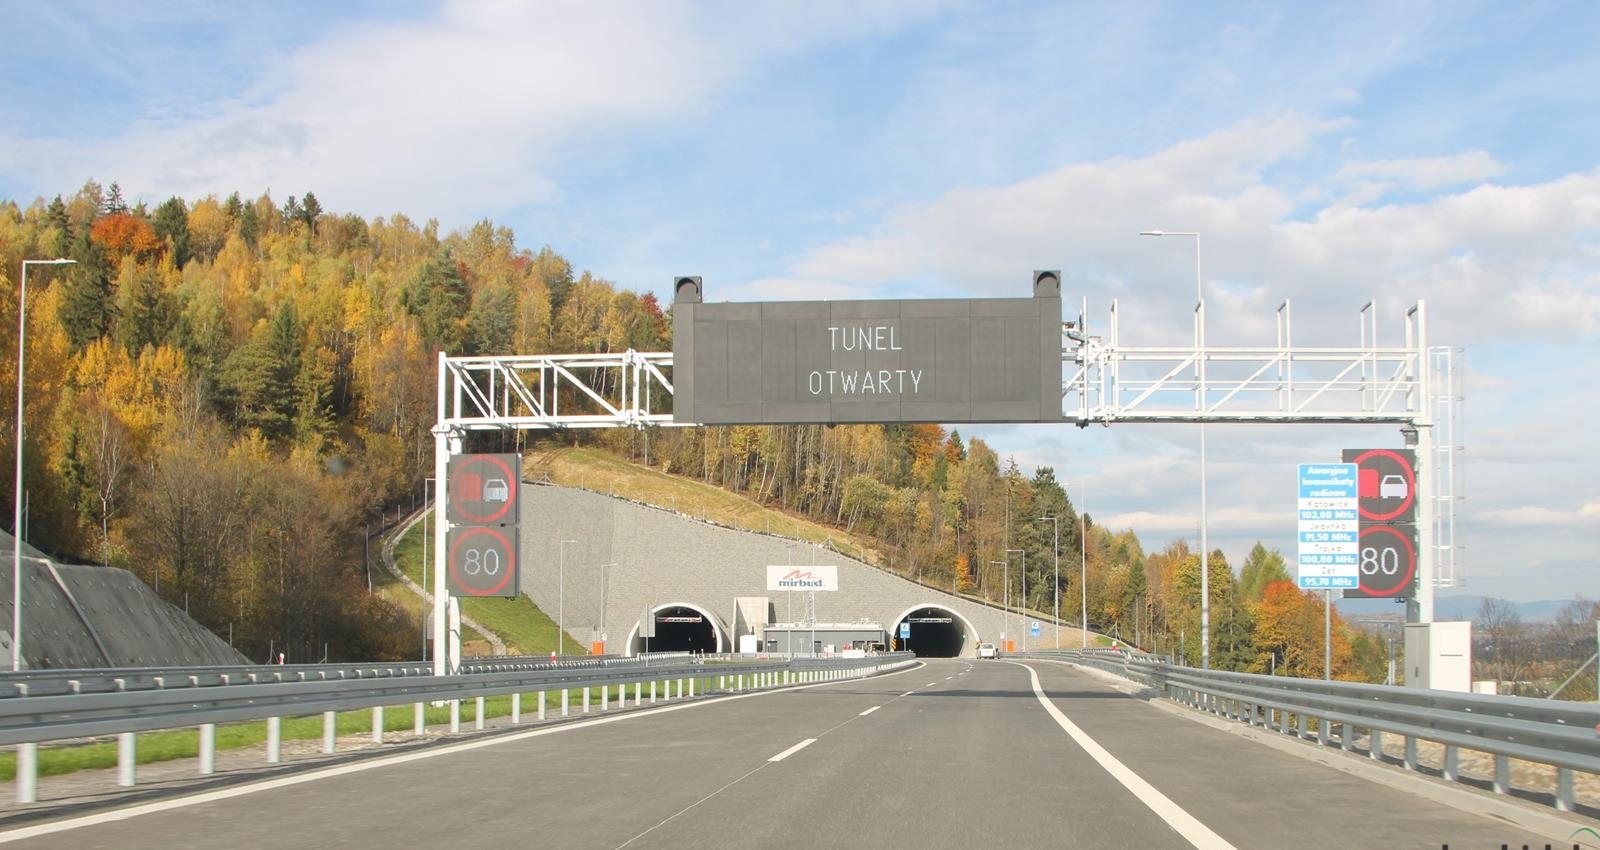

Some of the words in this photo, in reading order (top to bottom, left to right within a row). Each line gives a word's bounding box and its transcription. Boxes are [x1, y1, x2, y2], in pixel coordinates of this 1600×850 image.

[828, 326, 902, 351] TUNEL
[809, 370, 922, 395] OTWARTY
[1335, 511, 1355, 520] MHz
[1331, 533, 1352, 542] MHz
[464, 548, 499, 575] 80
[1335, 555, 1356, 564] MHz
[1360, 547, 1398, 575] 80
[778, 578, 823, 587] mirbud
[1332, 577, 1352, 587] MHz
